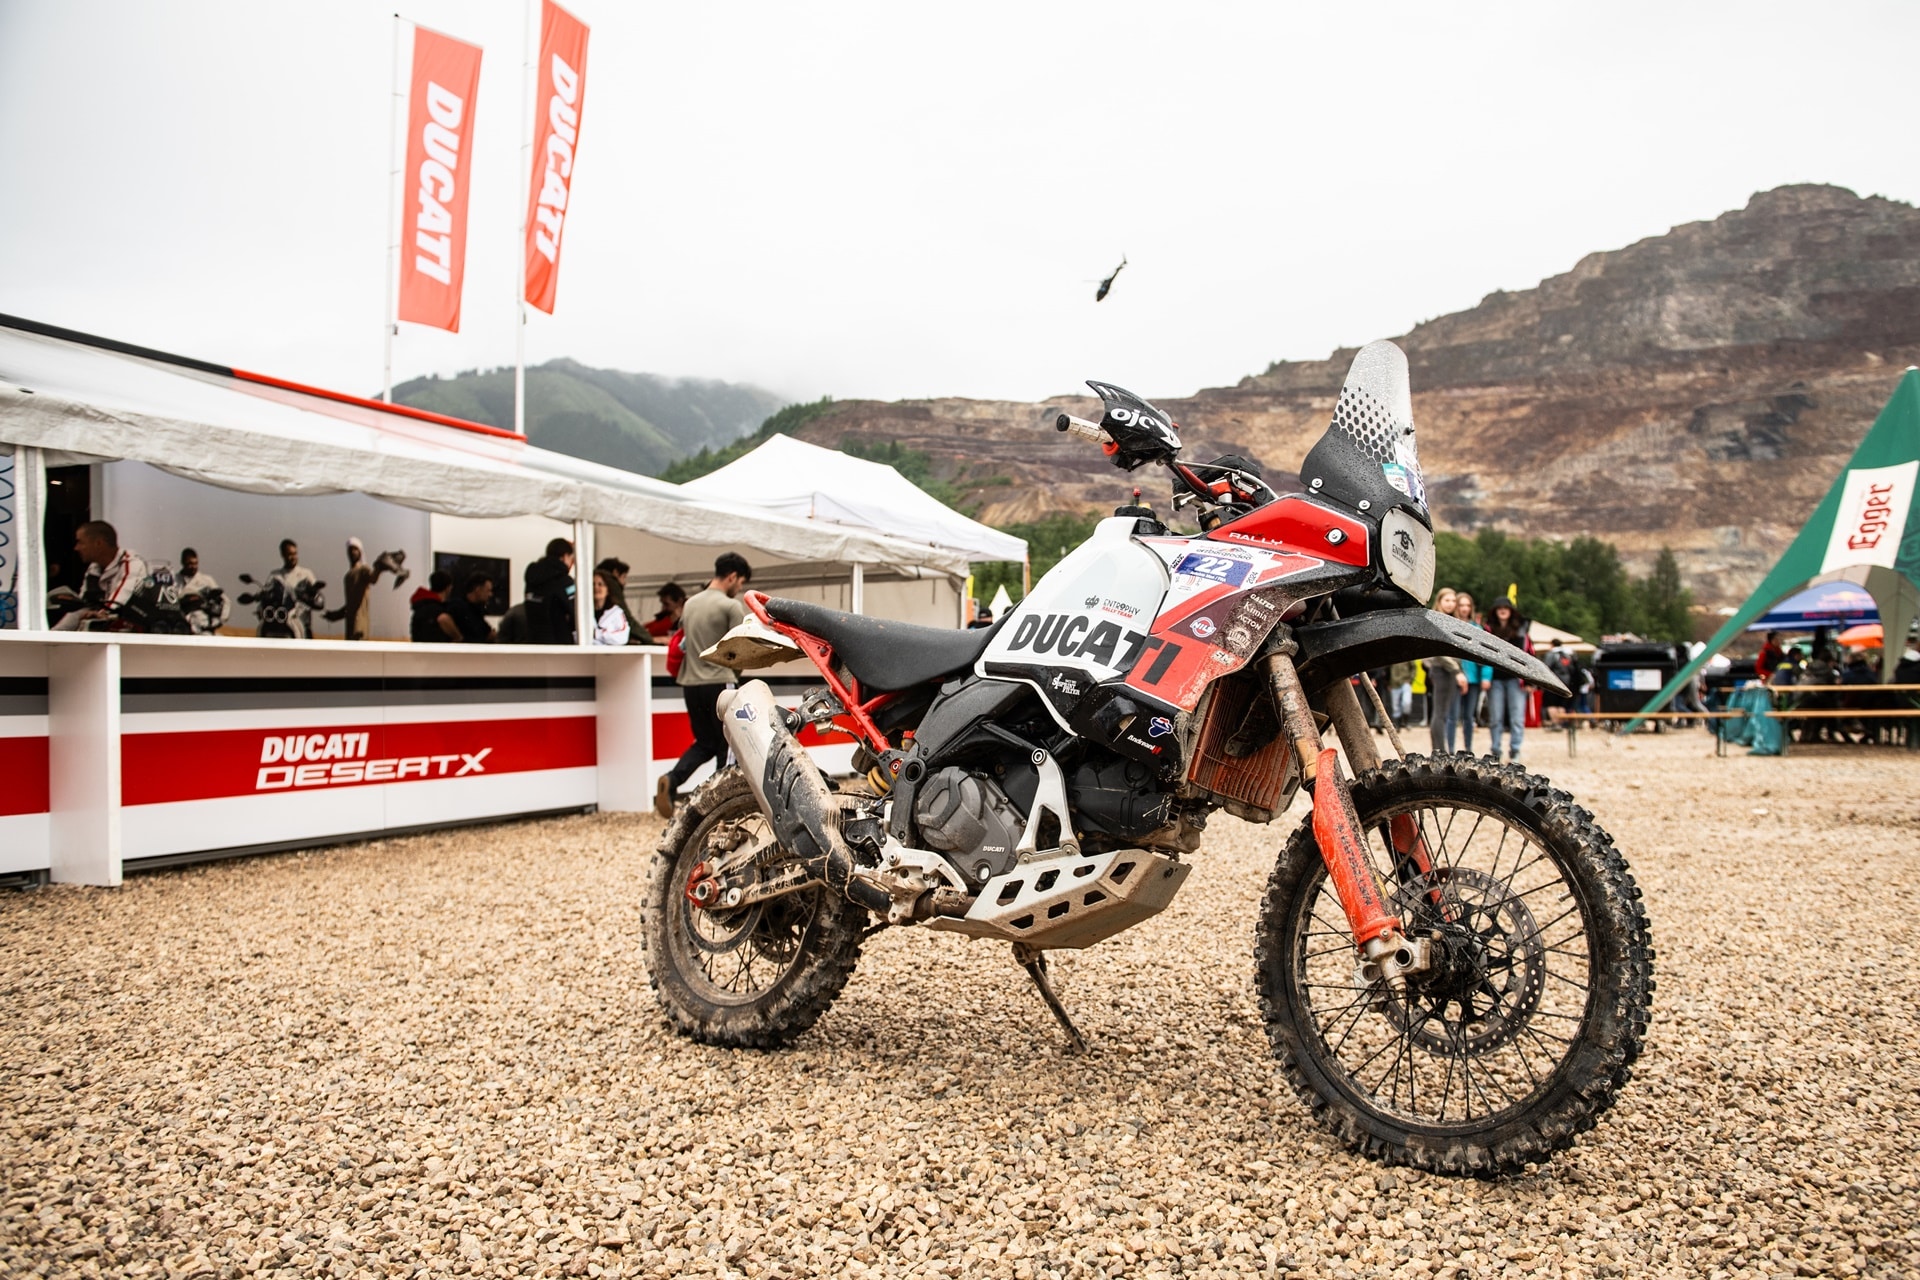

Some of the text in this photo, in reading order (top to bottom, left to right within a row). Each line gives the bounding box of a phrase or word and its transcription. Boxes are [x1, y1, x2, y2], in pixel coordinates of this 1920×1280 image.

[536, 53, 578, 263] DUCATI
[416, 80, 463, 286] DUCATI
[1848, 483, 1894, 551] Egger
[1229, 532, 1283, 545] RALLY
[1195, 556, 1234, 577] 22
[1243, 601, 1267, 621] Kimia
[1250, 593, 1276, 611] GALFER
[1117, 610, 1133, 618] TEAM
[1237, 614, 1262, 630] ACTON
[1007, 614, 1183, 685] DUCATI
[260, 732, 369, 763] DUCATI
[256, 748, 493, 789] DESERTX
[983, 845, 1005, 853] DUCATI
